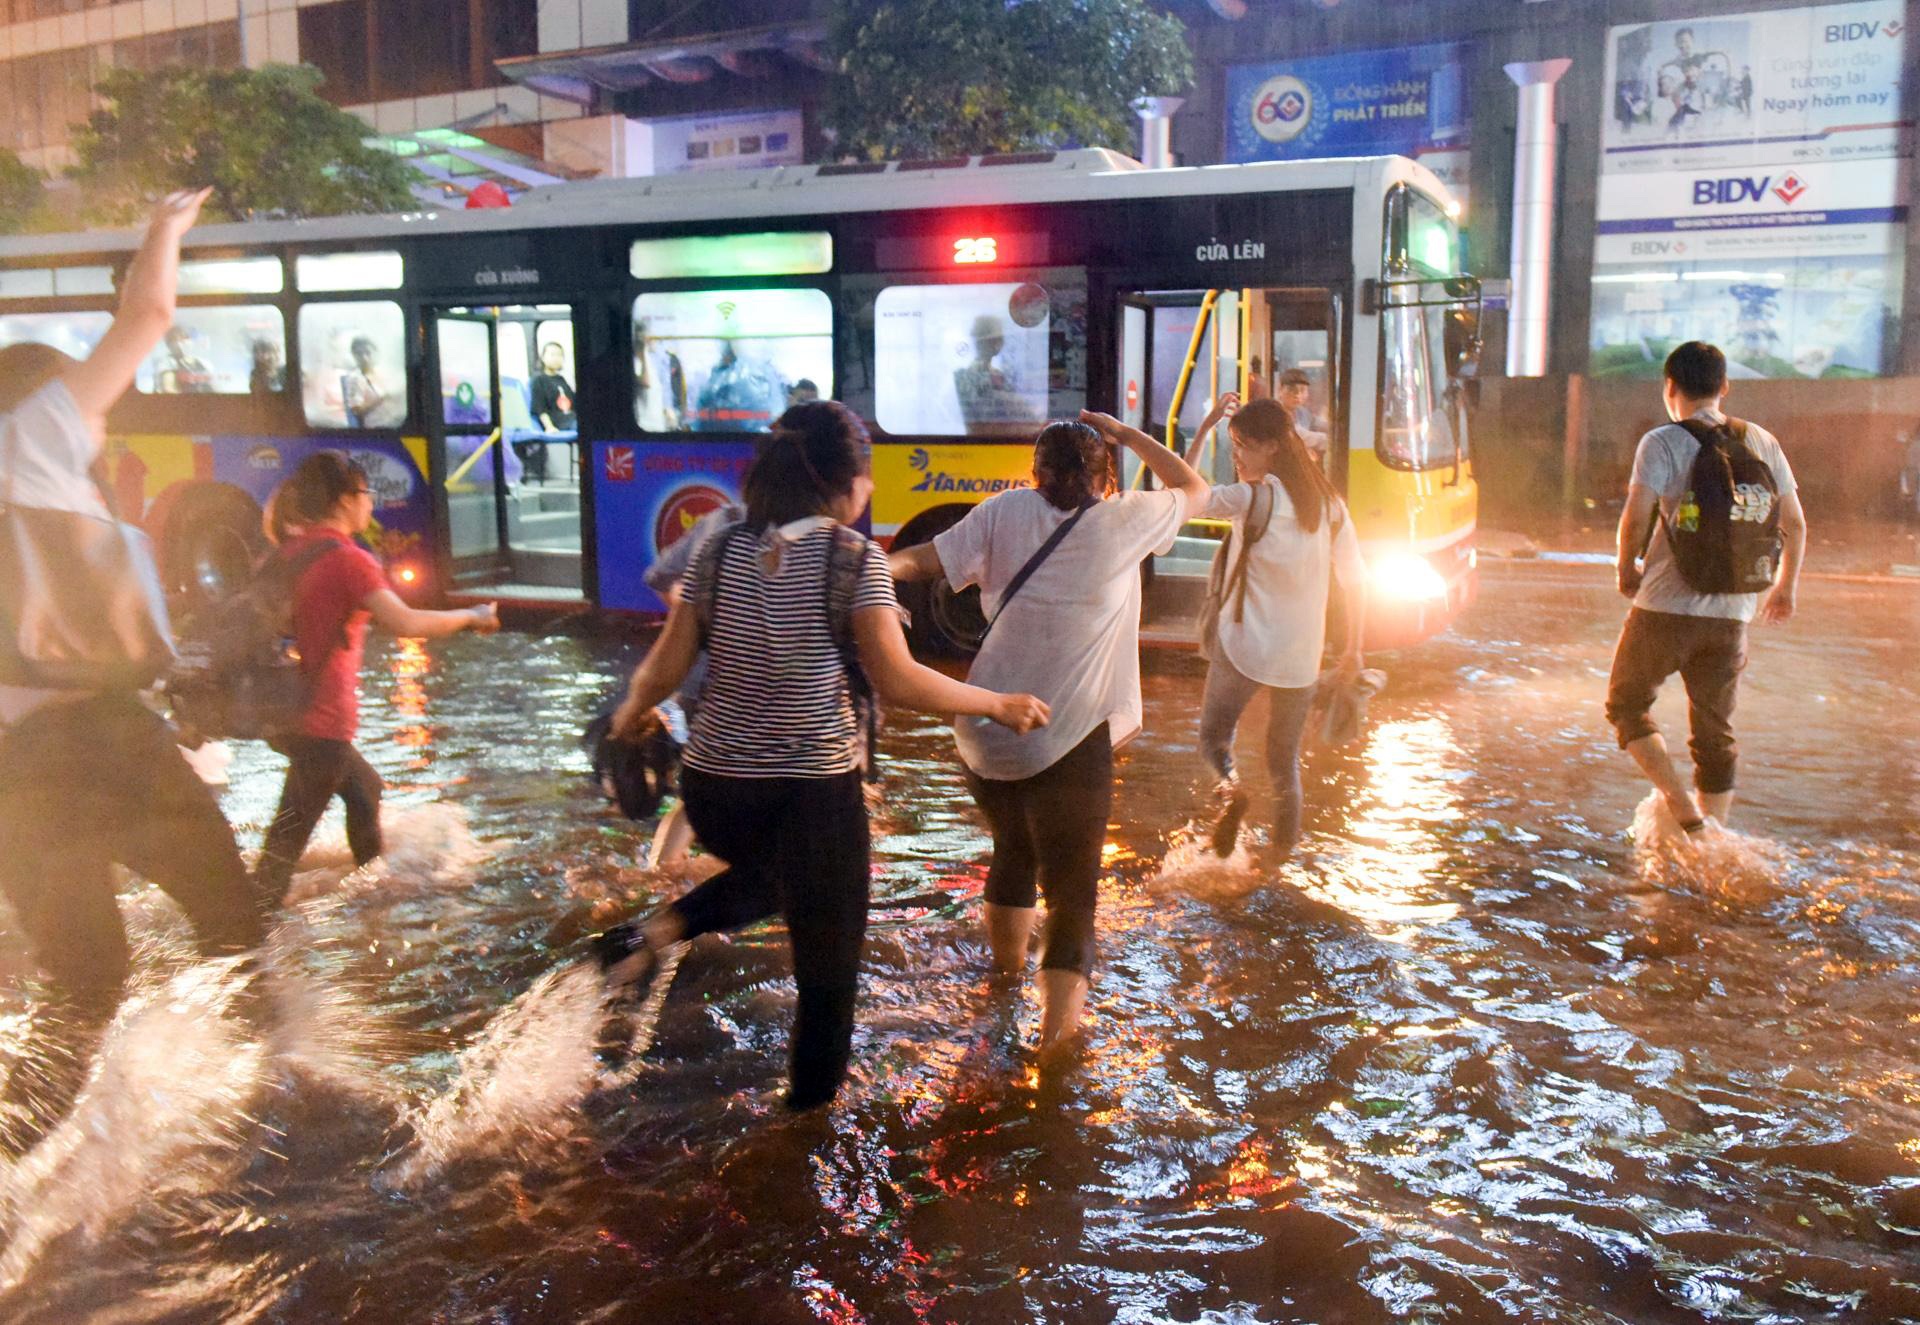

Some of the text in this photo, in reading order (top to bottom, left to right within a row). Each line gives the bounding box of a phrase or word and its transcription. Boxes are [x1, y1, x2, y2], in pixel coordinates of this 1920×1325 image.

[1825, 21, 1880, 43] BIDV
[1763, 91, 1889, 113] Ngay hôm nay
[1692, 176, 1770, 205] BIDV
[1196, 237, 1265, 261] CỬA LÊN
[1631, 240, 1671, 256] BIDV
